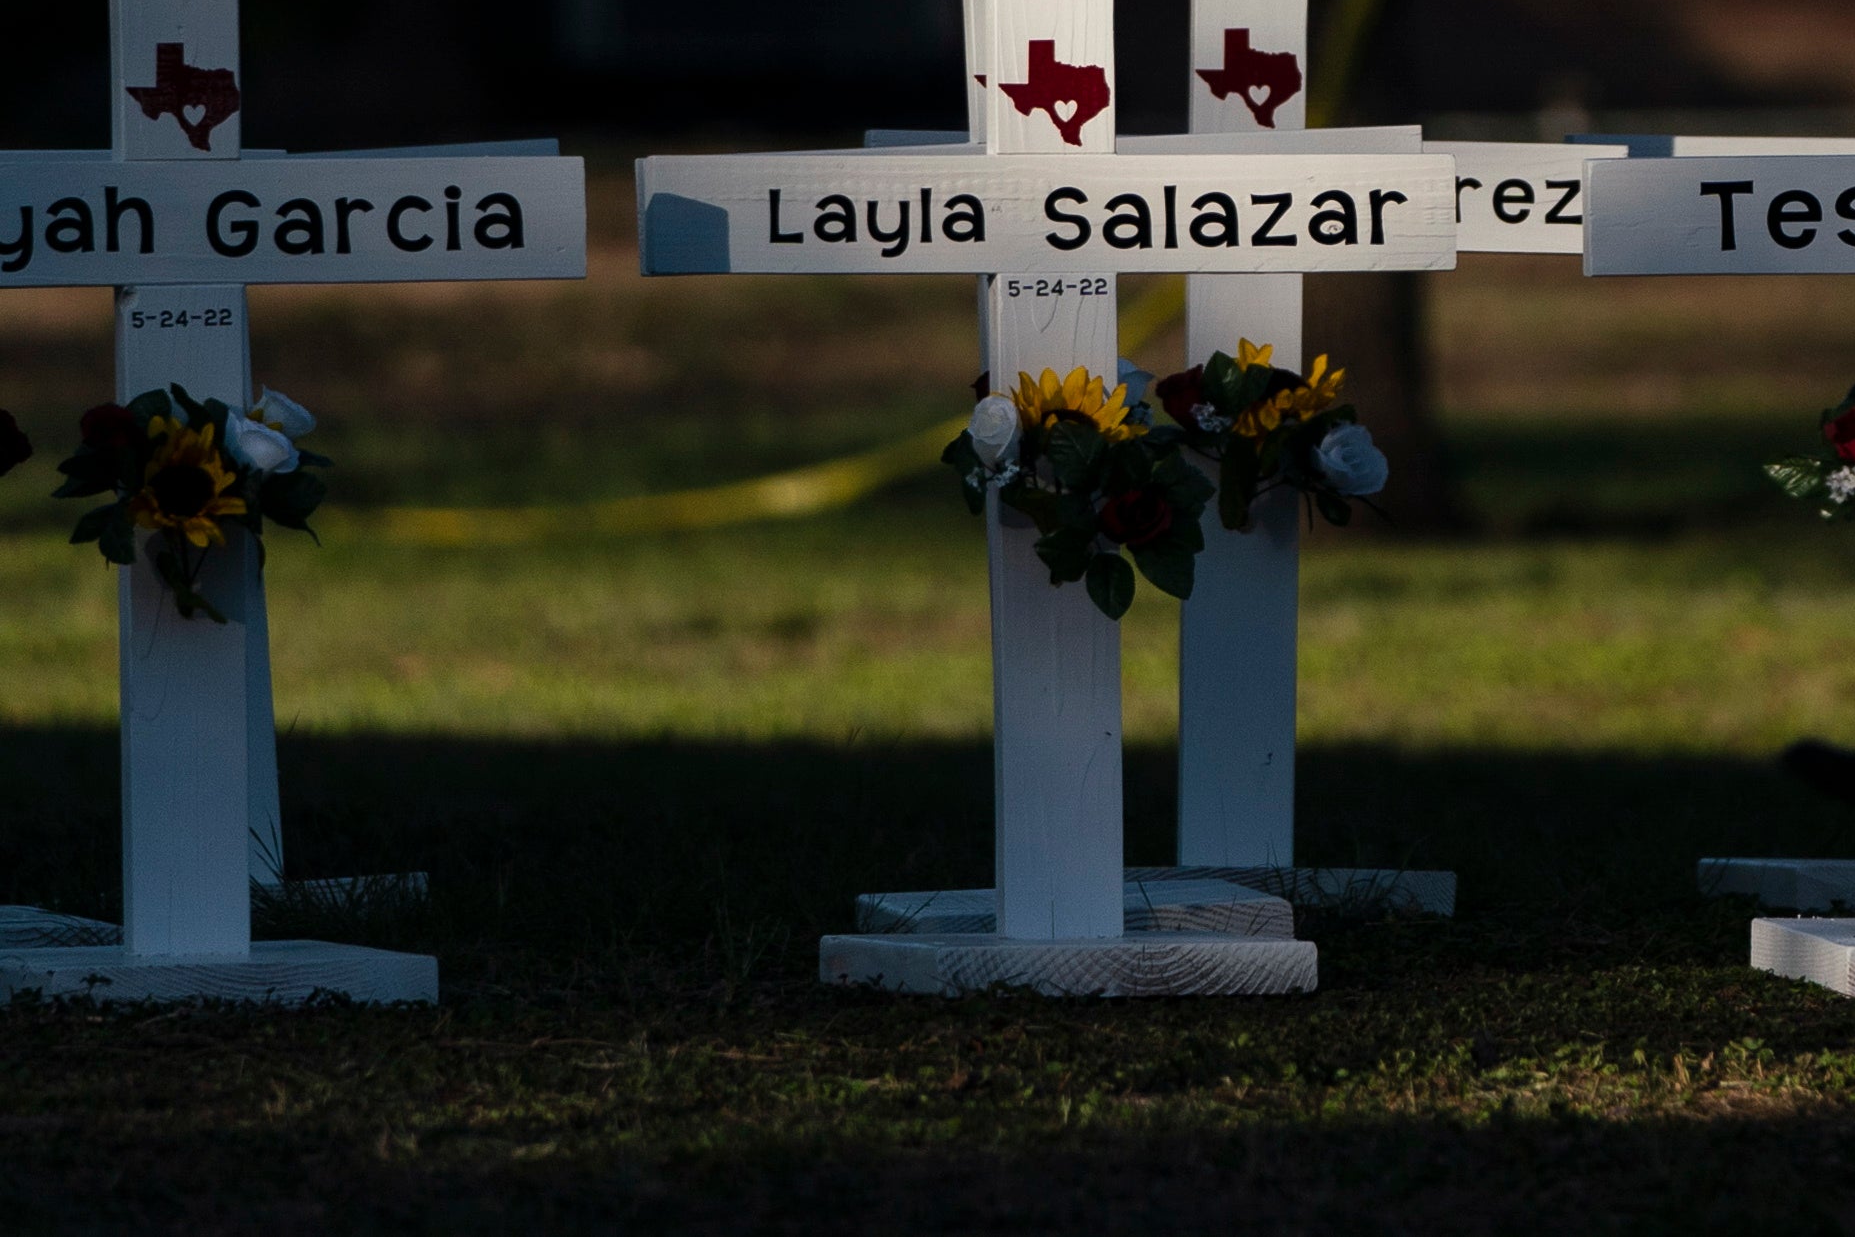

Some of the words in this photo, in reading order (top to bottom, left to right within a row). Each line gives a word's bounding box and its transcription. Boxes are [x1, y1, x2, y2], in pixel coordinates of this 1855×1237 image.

[206, 185, 525, 258] Garcia
[769, 188, 986, 257] Layla
[1044, 186, 1408, 250] Salazar
[1456, 176, 1583, 224] rez
[1008, 278, 1108, 297] 5-24-22
[132, 309, 232, 328] 5-24-22
